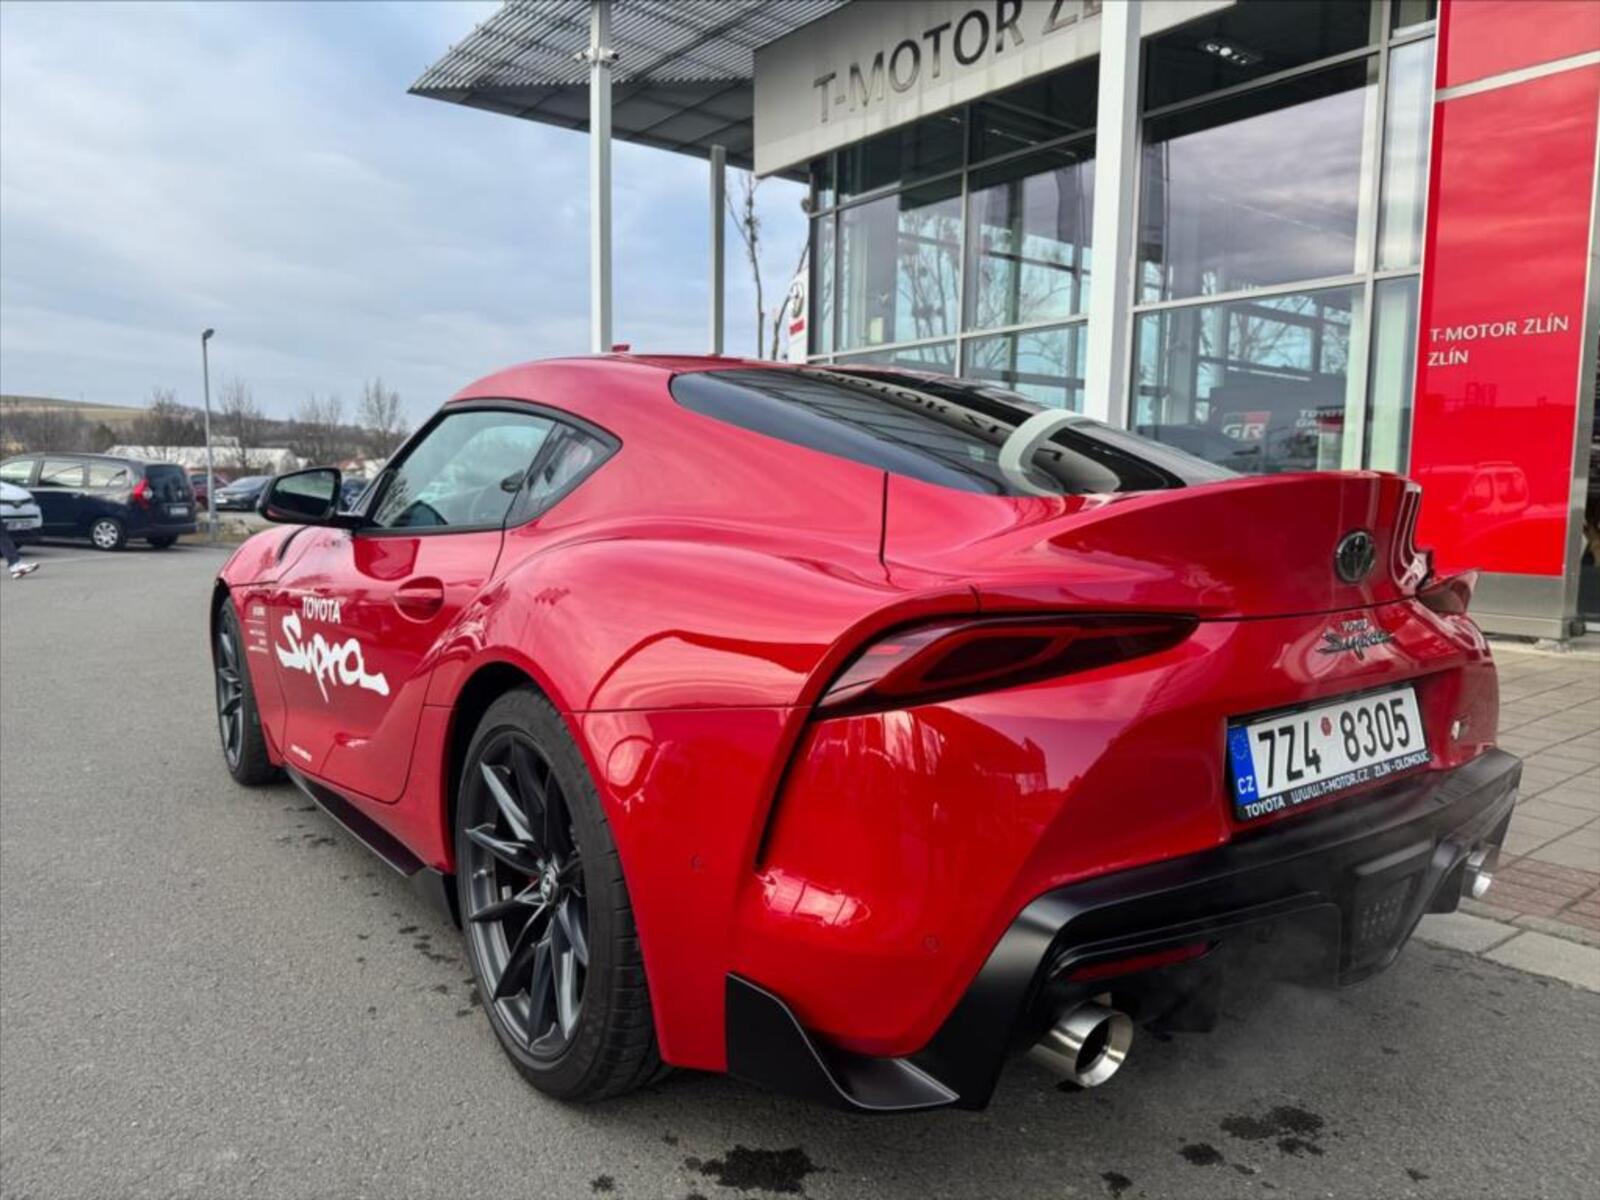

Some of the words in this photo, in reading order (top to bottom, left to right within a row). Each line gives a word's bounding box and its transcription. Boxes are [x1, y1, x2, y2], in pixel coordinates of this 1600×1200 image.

[813, 0, 1025, 123] T-MOTOR
[1430, 321, 1517, 342] T-MOTOR
[1523, 312, 1569, 335] ZLÍN
[1427, 346, 1469, 367] ZLÍN
[302, 597, 342, 624] TOYOTA
[275, 611, 390, 703] Supra
[1258, 720, 1321, 789] 7Z4
[1339, 697, 1410, 763] 8305
[1237, 776, 1254, 795] CZ
[1245, 795, 1286, 818] TOYOTA
